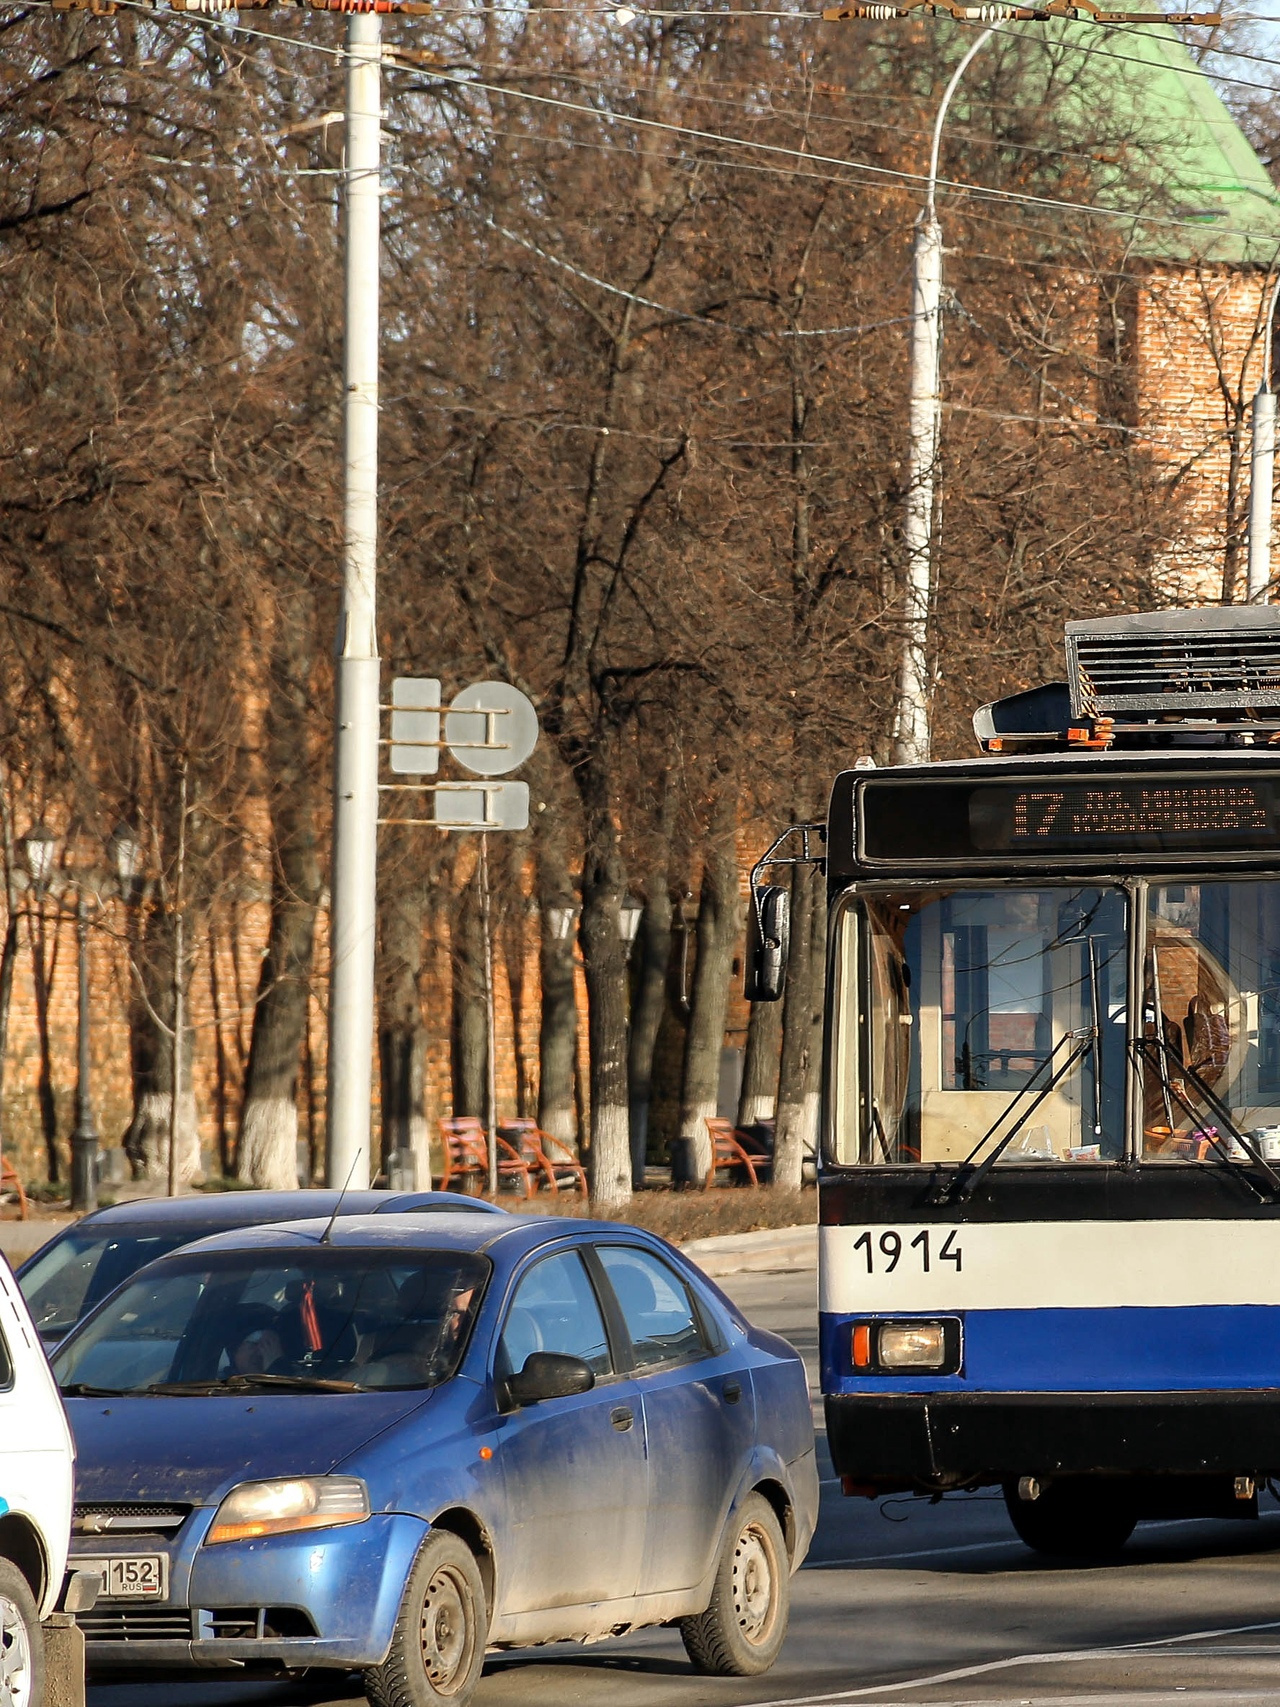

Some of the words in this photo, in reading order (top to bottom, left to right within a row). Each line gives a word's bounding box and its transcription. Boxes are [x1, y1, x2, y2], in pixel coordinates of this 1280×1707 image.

[1142, 787, 1256, 809] МИНИНА
[1013, 792, 1065, 836] 17
[853, 1229, 963, 1274] 1914
[113, 1561, 153, 1583] 152
[122, 1583, 142, 1591] RUS
